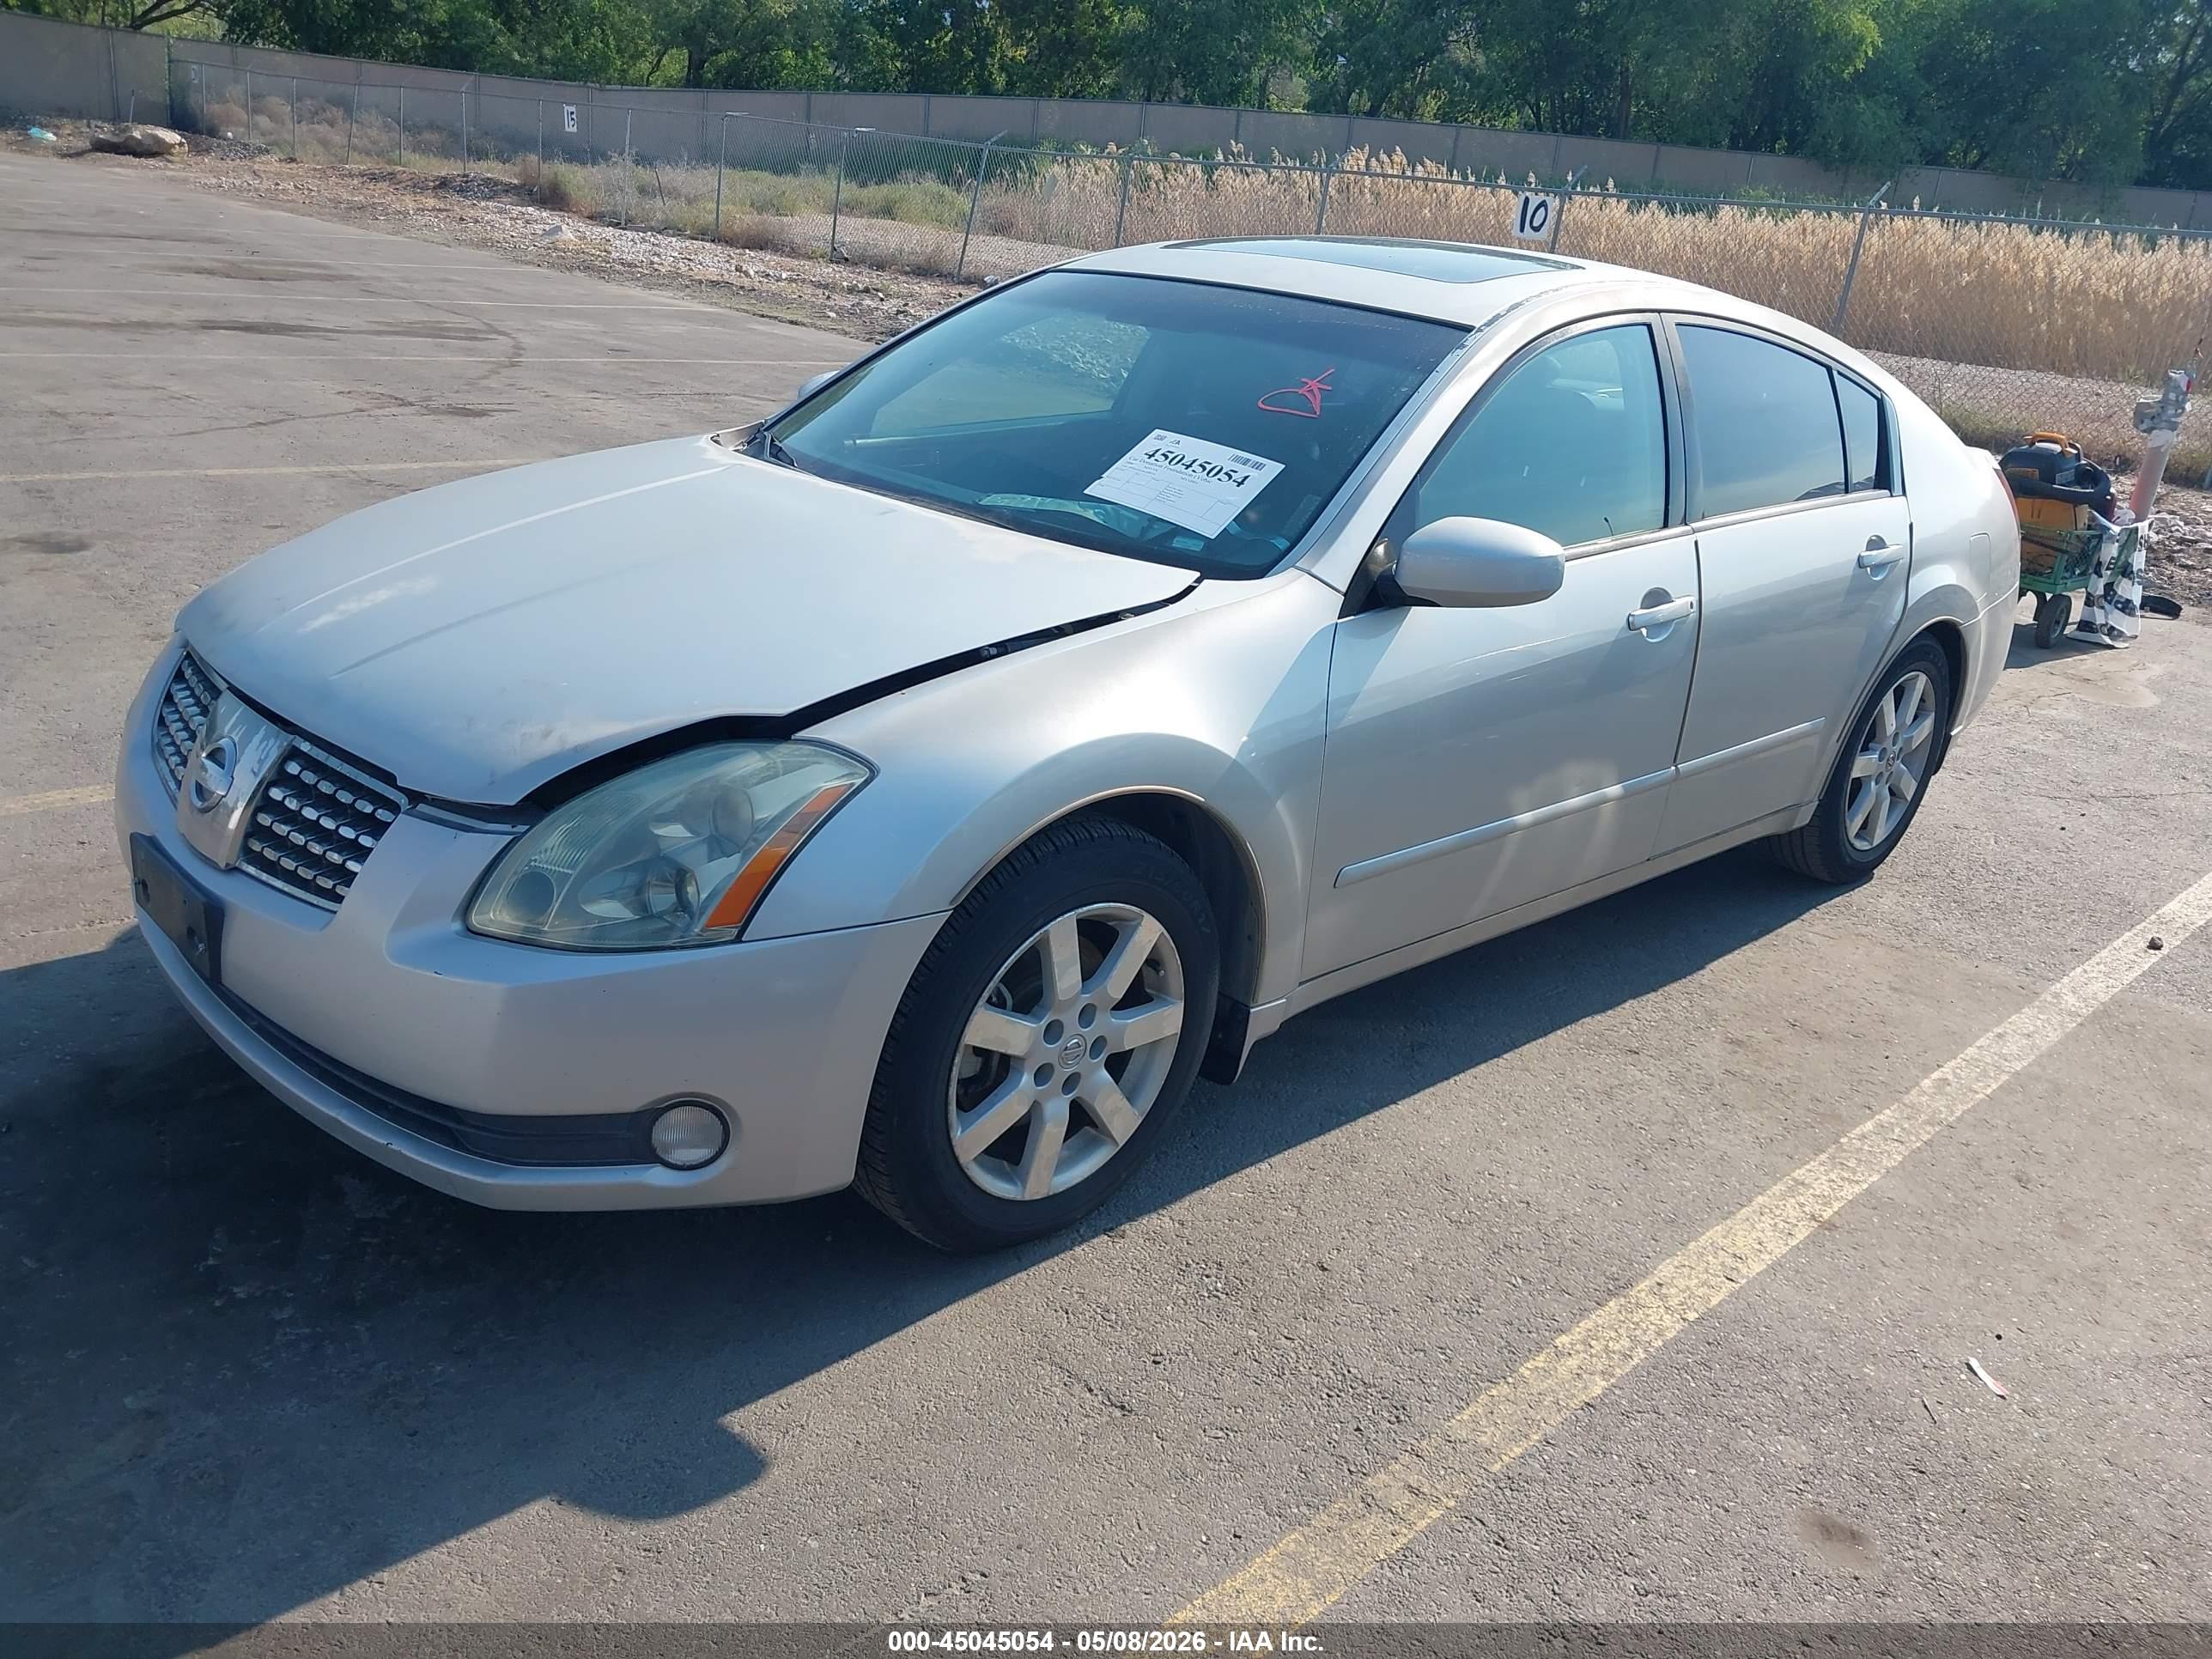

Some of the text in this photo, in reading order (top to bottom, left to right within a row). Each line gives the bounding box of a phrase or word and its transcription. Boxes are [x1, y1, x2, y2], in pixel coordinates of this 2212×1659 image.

[567, 109, 575, 128] 15
[1519, 196, 1548, 233] 10
[1144, 447, 1251, 488] 45045054
